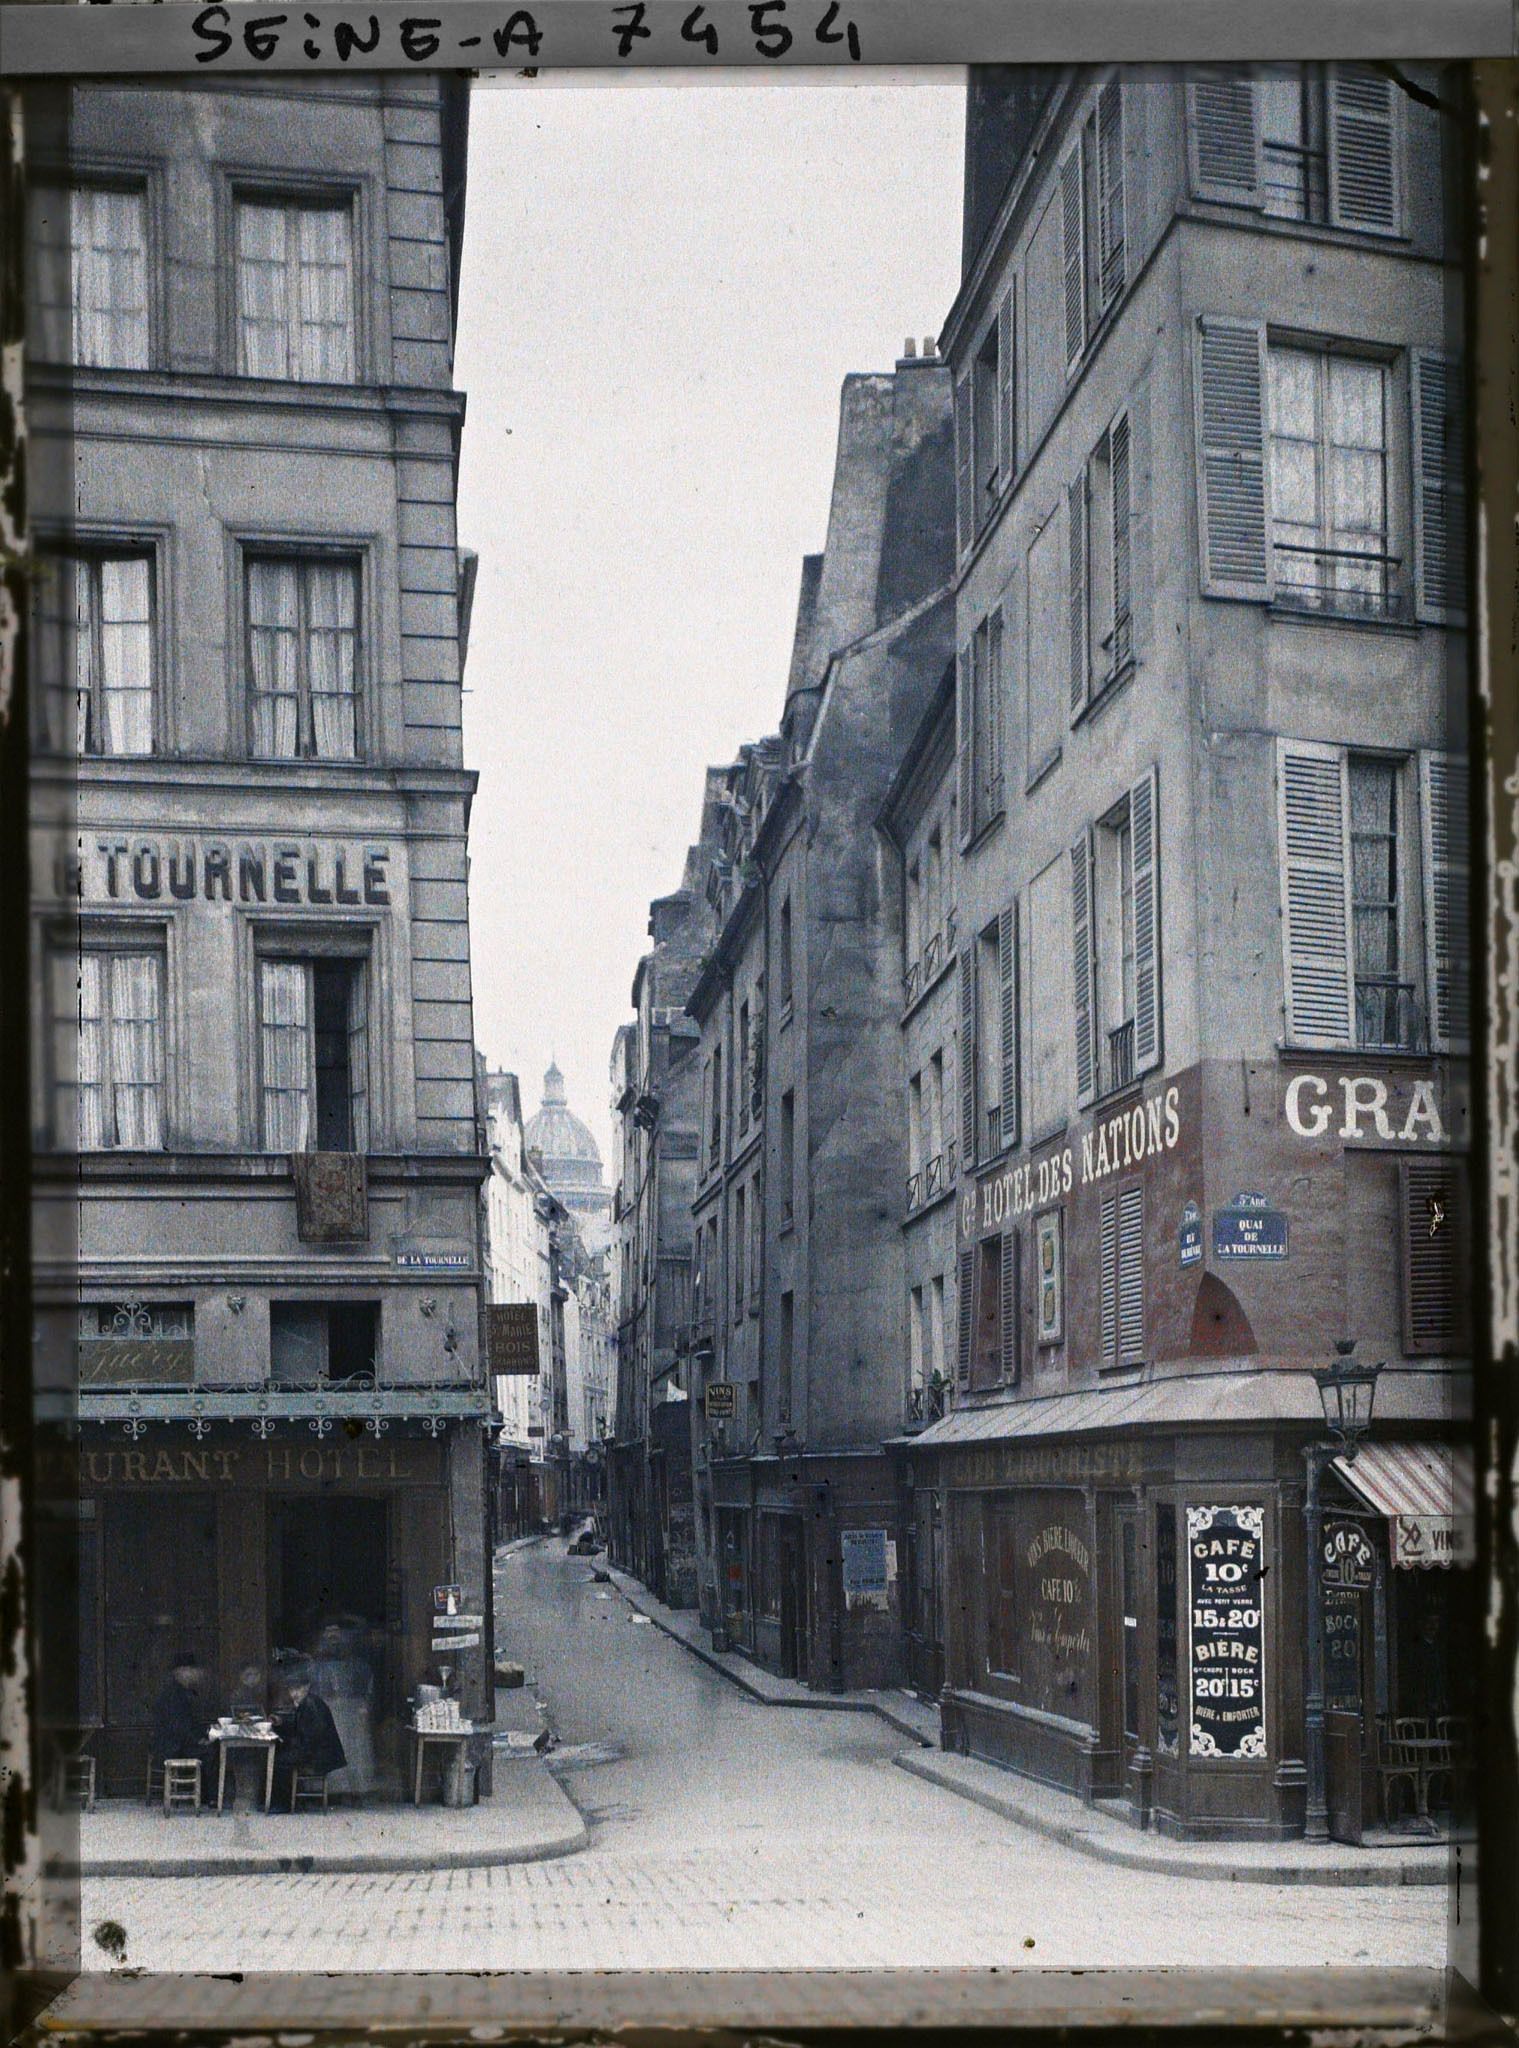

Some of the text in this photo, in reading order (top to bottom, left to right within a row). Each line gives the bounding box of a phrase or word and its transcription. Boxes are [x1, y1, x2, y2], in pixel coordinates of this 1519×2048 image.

[98, 837, 391, 905] TOURNELLE
[982, 1163, 1034, 1228] HOTEL
[1038, 1148, 1072, 1203] DES
[1081, 1086, 1180, 1184] NATIONS
[1239, 1219, 1264, 1231] QUAI
[1244, 1232, 1258, 1241] DE
[1232, 1244, 1286, 1254] TOURNELLE
[410, 1256, 421, 1264] LA
[424, 1256, 467, 1265] TOURNELLE
[80, 1447, 412, 1482] URANT HOTEL
[1201, 1584, 1247, 1594] LA TASSE
[1222, 1705, 1261, 1722] EMPORTER
